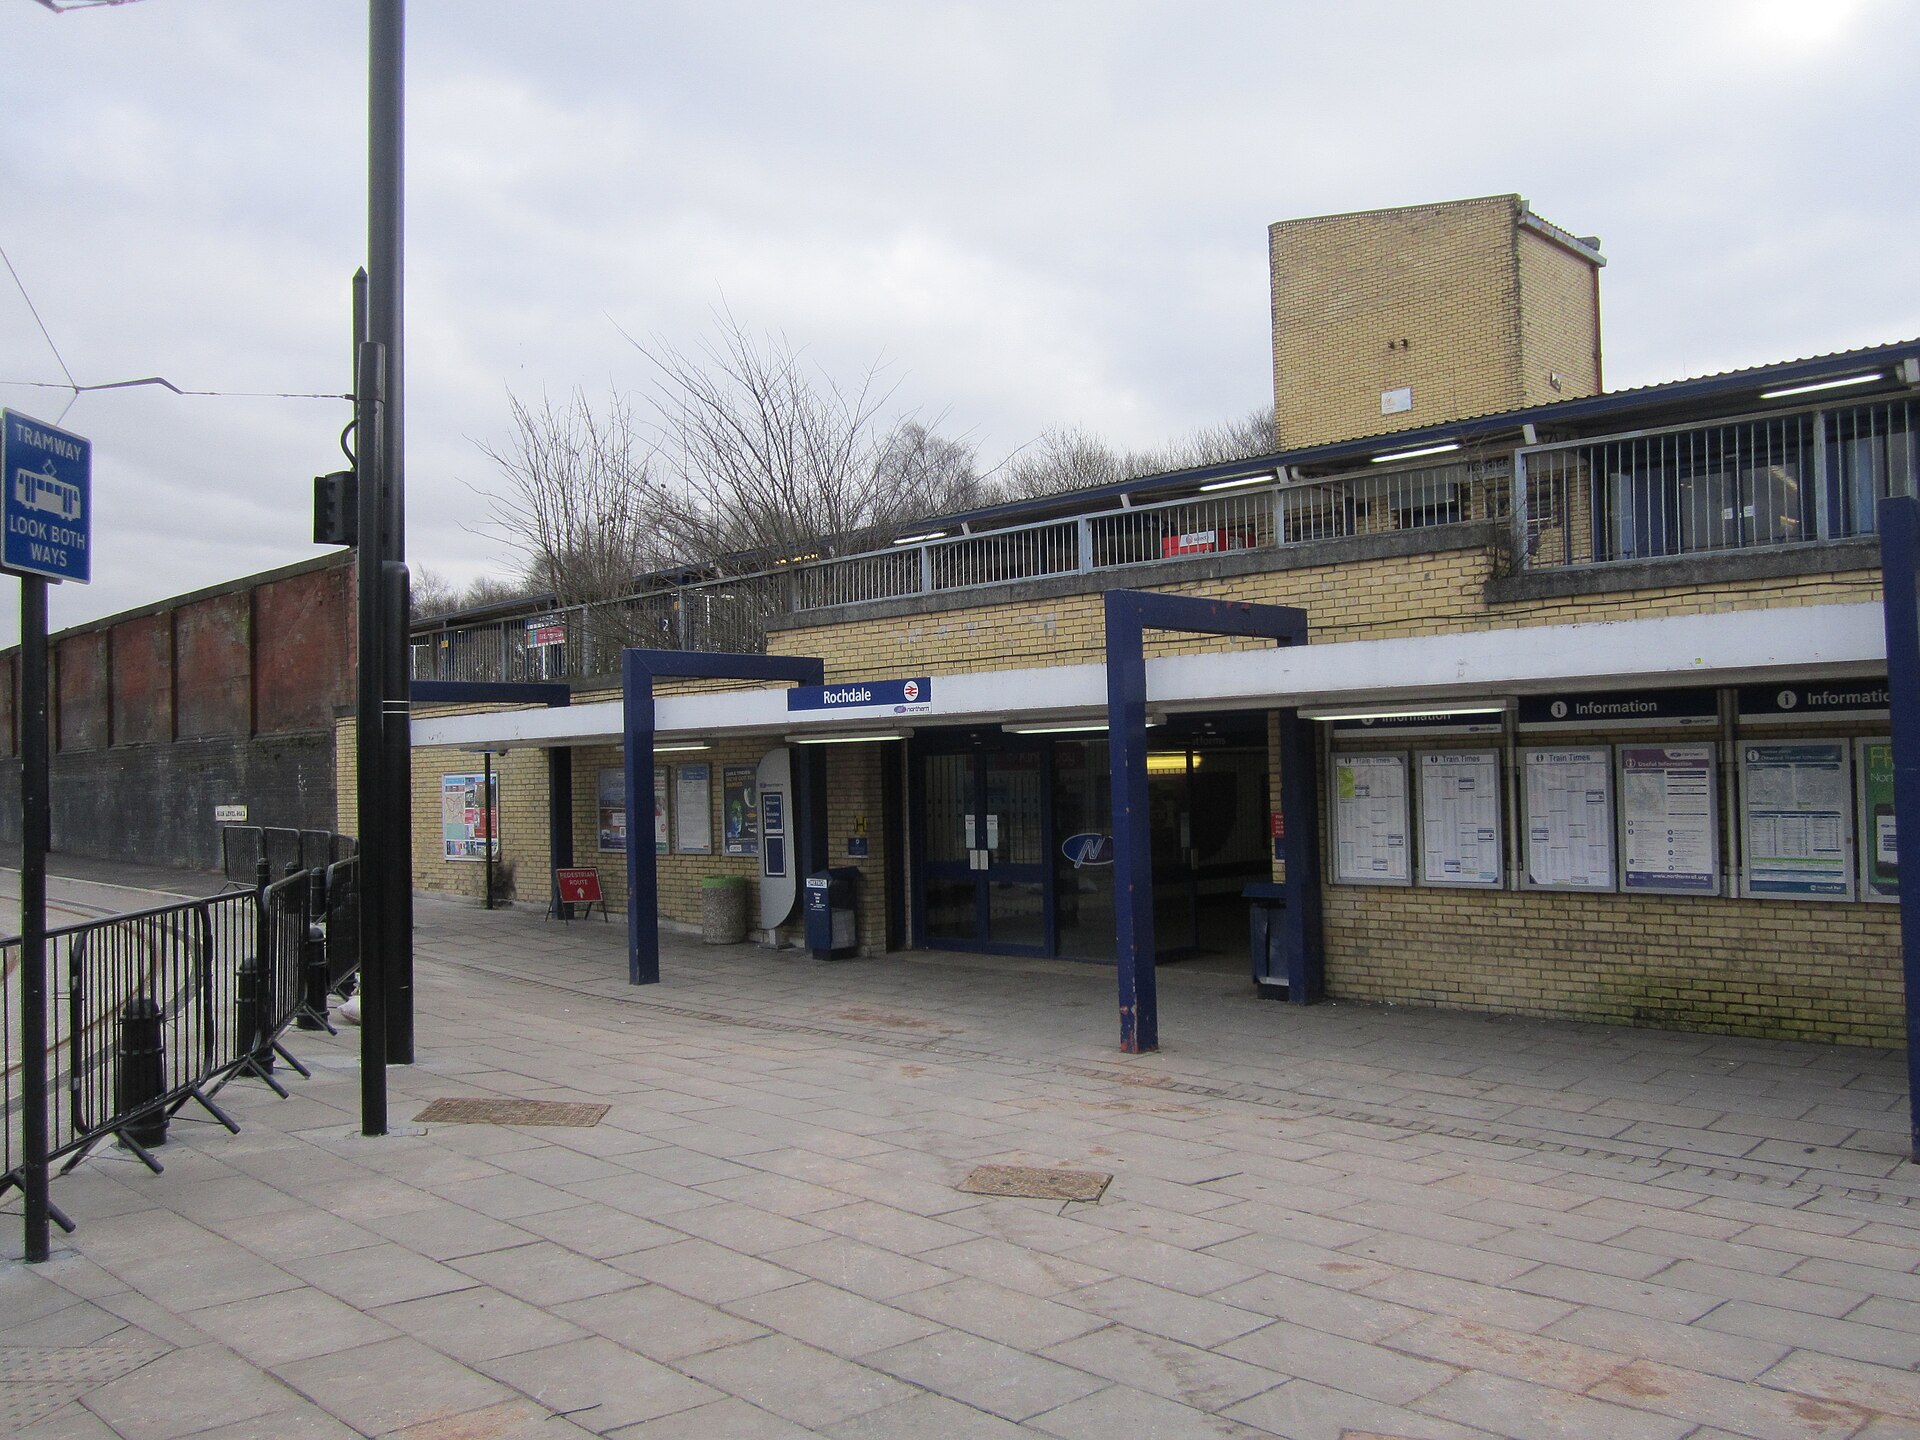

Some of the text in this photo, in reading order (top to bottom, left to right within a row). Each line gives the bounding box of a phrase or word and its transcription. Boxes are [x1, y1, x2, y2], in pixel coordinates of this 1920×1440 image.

[15, 424, 81, 462] TRAMWAY
[10, 514, 86, 550] LOOK BOTH
[30, 542, 67, 567] WAYS
[823, 687, 872, 704] Rochdale
[1807, 689, 1890, 705] Informatio
[1576, 699, 1657, 715] Information
[1442, 755, 1459, 763] Train
[1548, 754, 1567, 762] Train
